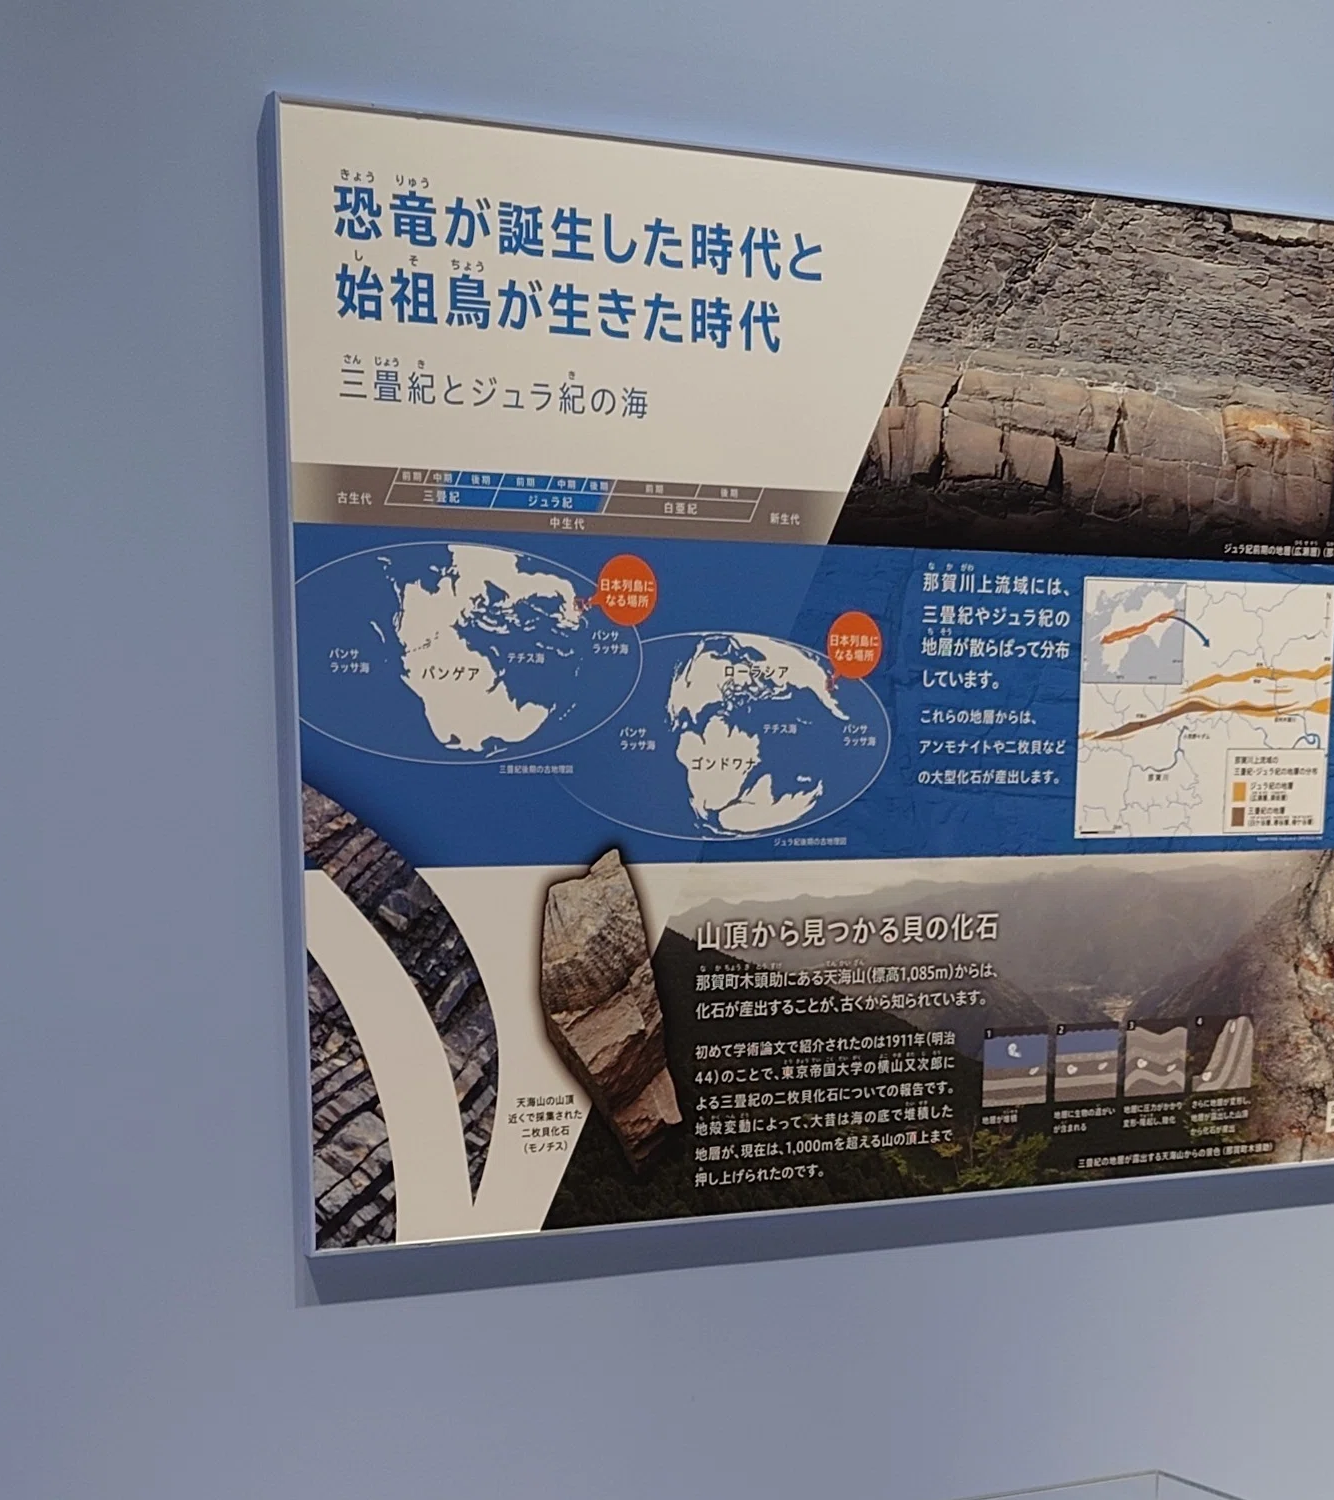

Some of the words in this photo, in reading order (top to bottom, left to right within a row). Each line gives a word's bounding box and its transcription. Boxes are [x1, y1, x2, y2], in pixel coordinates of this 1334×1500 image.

[334, 183, 823, 282] 恐竜が誕生した時代と
[335, 262, 781, 353] 始祖鳥が生きた時代
[339, 367, 648, 420] 三畳紀とジュラ紀の海
[336, 490, 372, 507] 古生代
[423, 488, 460, 505] 三畳紀
[528, 494, 573, 511] ジュラ紀
[663, 500, 698, 516] 白亜紀
[549, 516, 585, 532] 中生代
[770, 512, 801, 527] 新生代
[599, 577, 654, 593] 日本列島に
[923, 571, 1071, 597] 那賀川上流域には、
[605, 592, 650, 609] なる場所
[922, 605, 1070, 629] 三畳紀やジュラ紀の
[921, 635, 1070, 660] 地層が散らばって分布
[507, 651, 545, 665] テチス海
[421, 665, 480, 682] パンゲア
[723, 664, 790, 680] ローラシア
[922, 669, 1000, 690] しています。
[920, 708, 1038, 726] これらの地層からは、
[919, 738, 1066, 757] アンモナイトや二枚貝など
[690, 755, 757, 773] ゴンドワナ
[918, 768, 1060, 786] の大型化石が産出します。
[697, 913, 999, 951] 山頂から見つかる貝の化石
[696, 990, 986, 1020] 化石が産出することが、古くから知られています。
[696, 1032, 955, 1059] 初めて学術論文で紹介されたのは1911年（明治
[695, 1058, 955, 1085] 44）のことで、東京帝国大学の横山又次郎に
[696, 1081, 954, 1111] よる三畳紀の二枚貝化石についての報告です。
[508, 1109, 583, 1123] 近くで採集された
[695, 1106, 953, 1136] 地殻変動によって、大昔は海の底で堆積した
[522, 1126, 570, 1138] 二枚貝化石
[695, 1165, 824, 1187] 押し上げられたのです。
